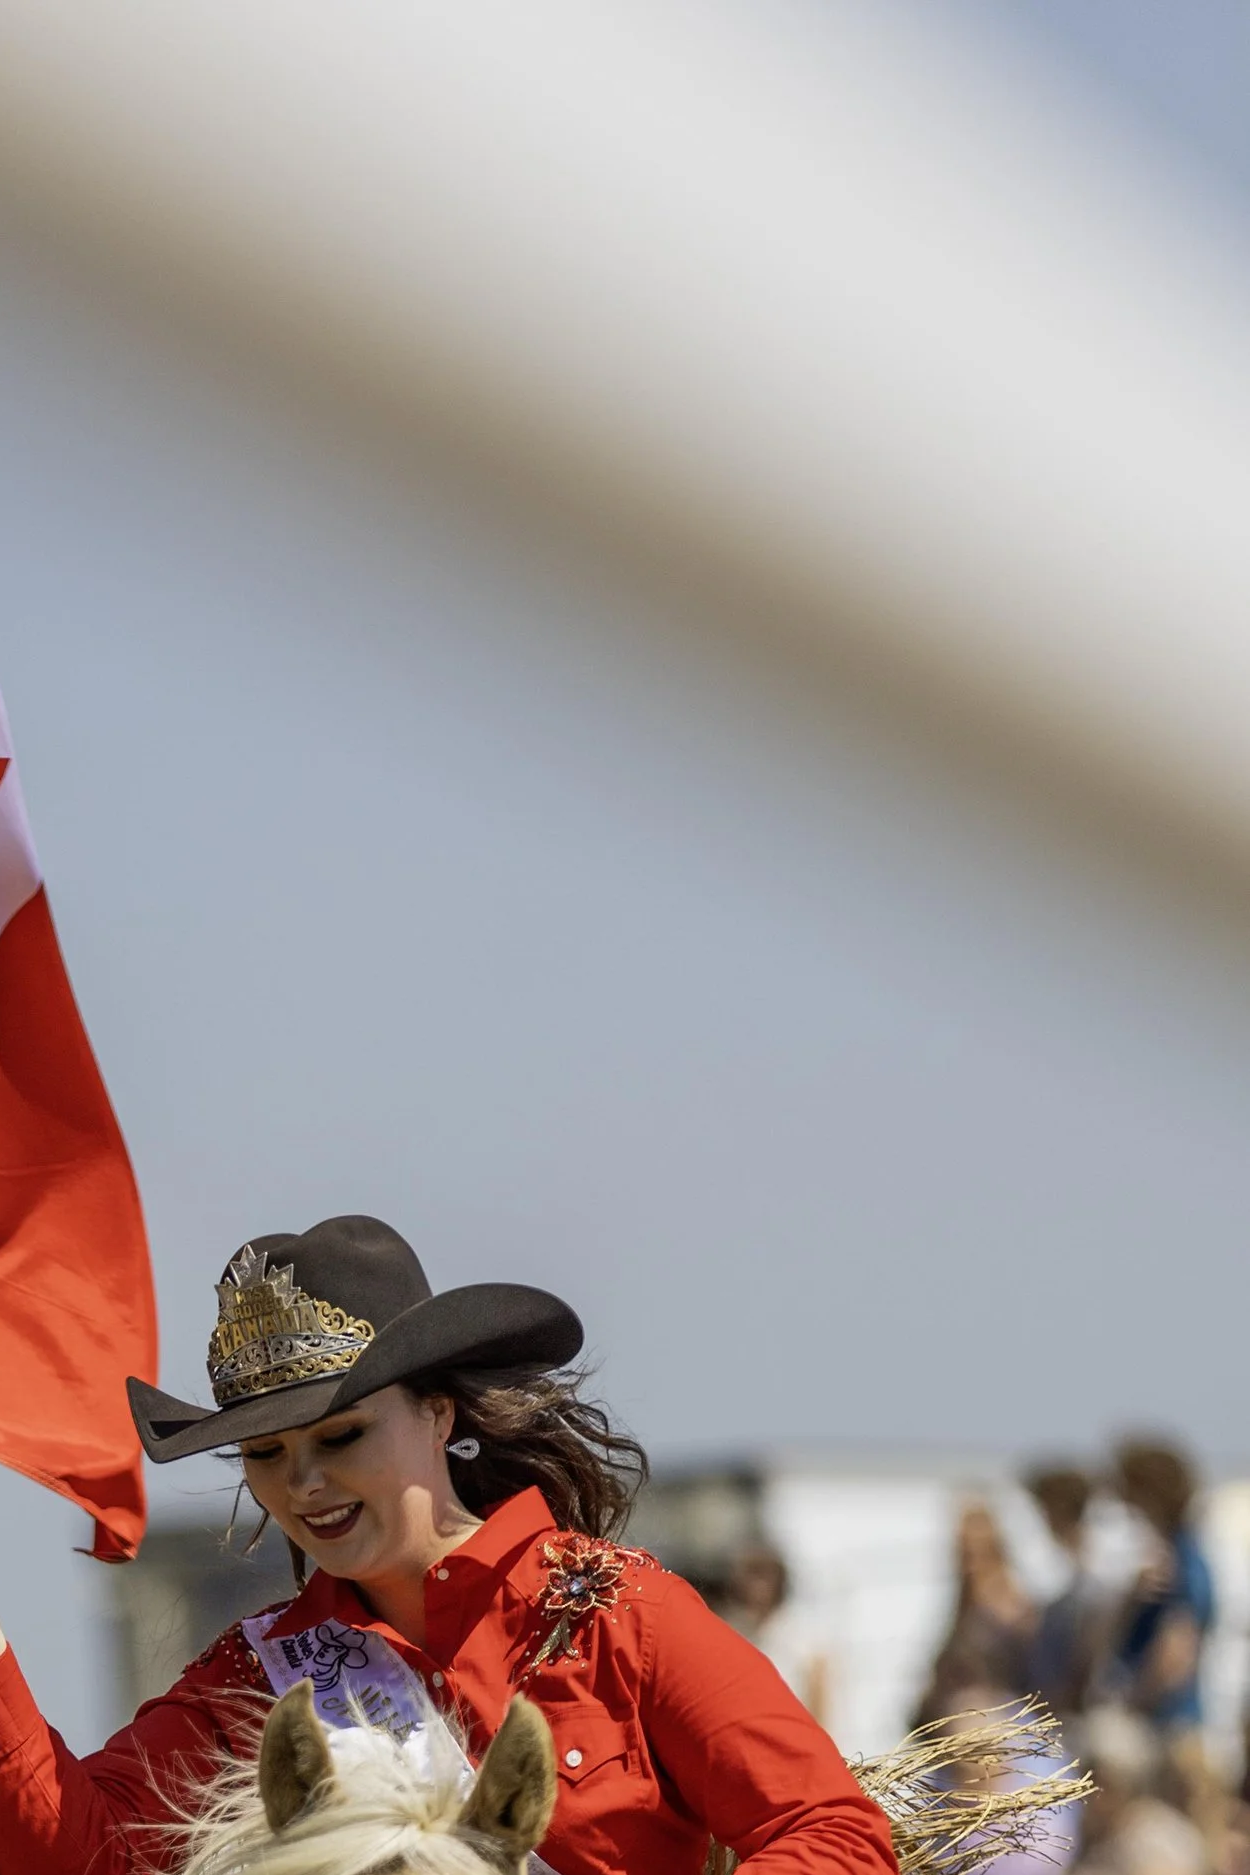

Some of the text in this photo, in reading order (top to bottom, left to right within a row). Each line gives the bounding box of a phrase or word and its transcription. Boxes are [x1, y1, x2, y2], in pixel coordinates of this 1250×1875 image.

[233, 1297, 286, 1319] RODEO
[218, 1301, 319, 1358] CANADA
[280, 1639, 303, 1670] Canada
